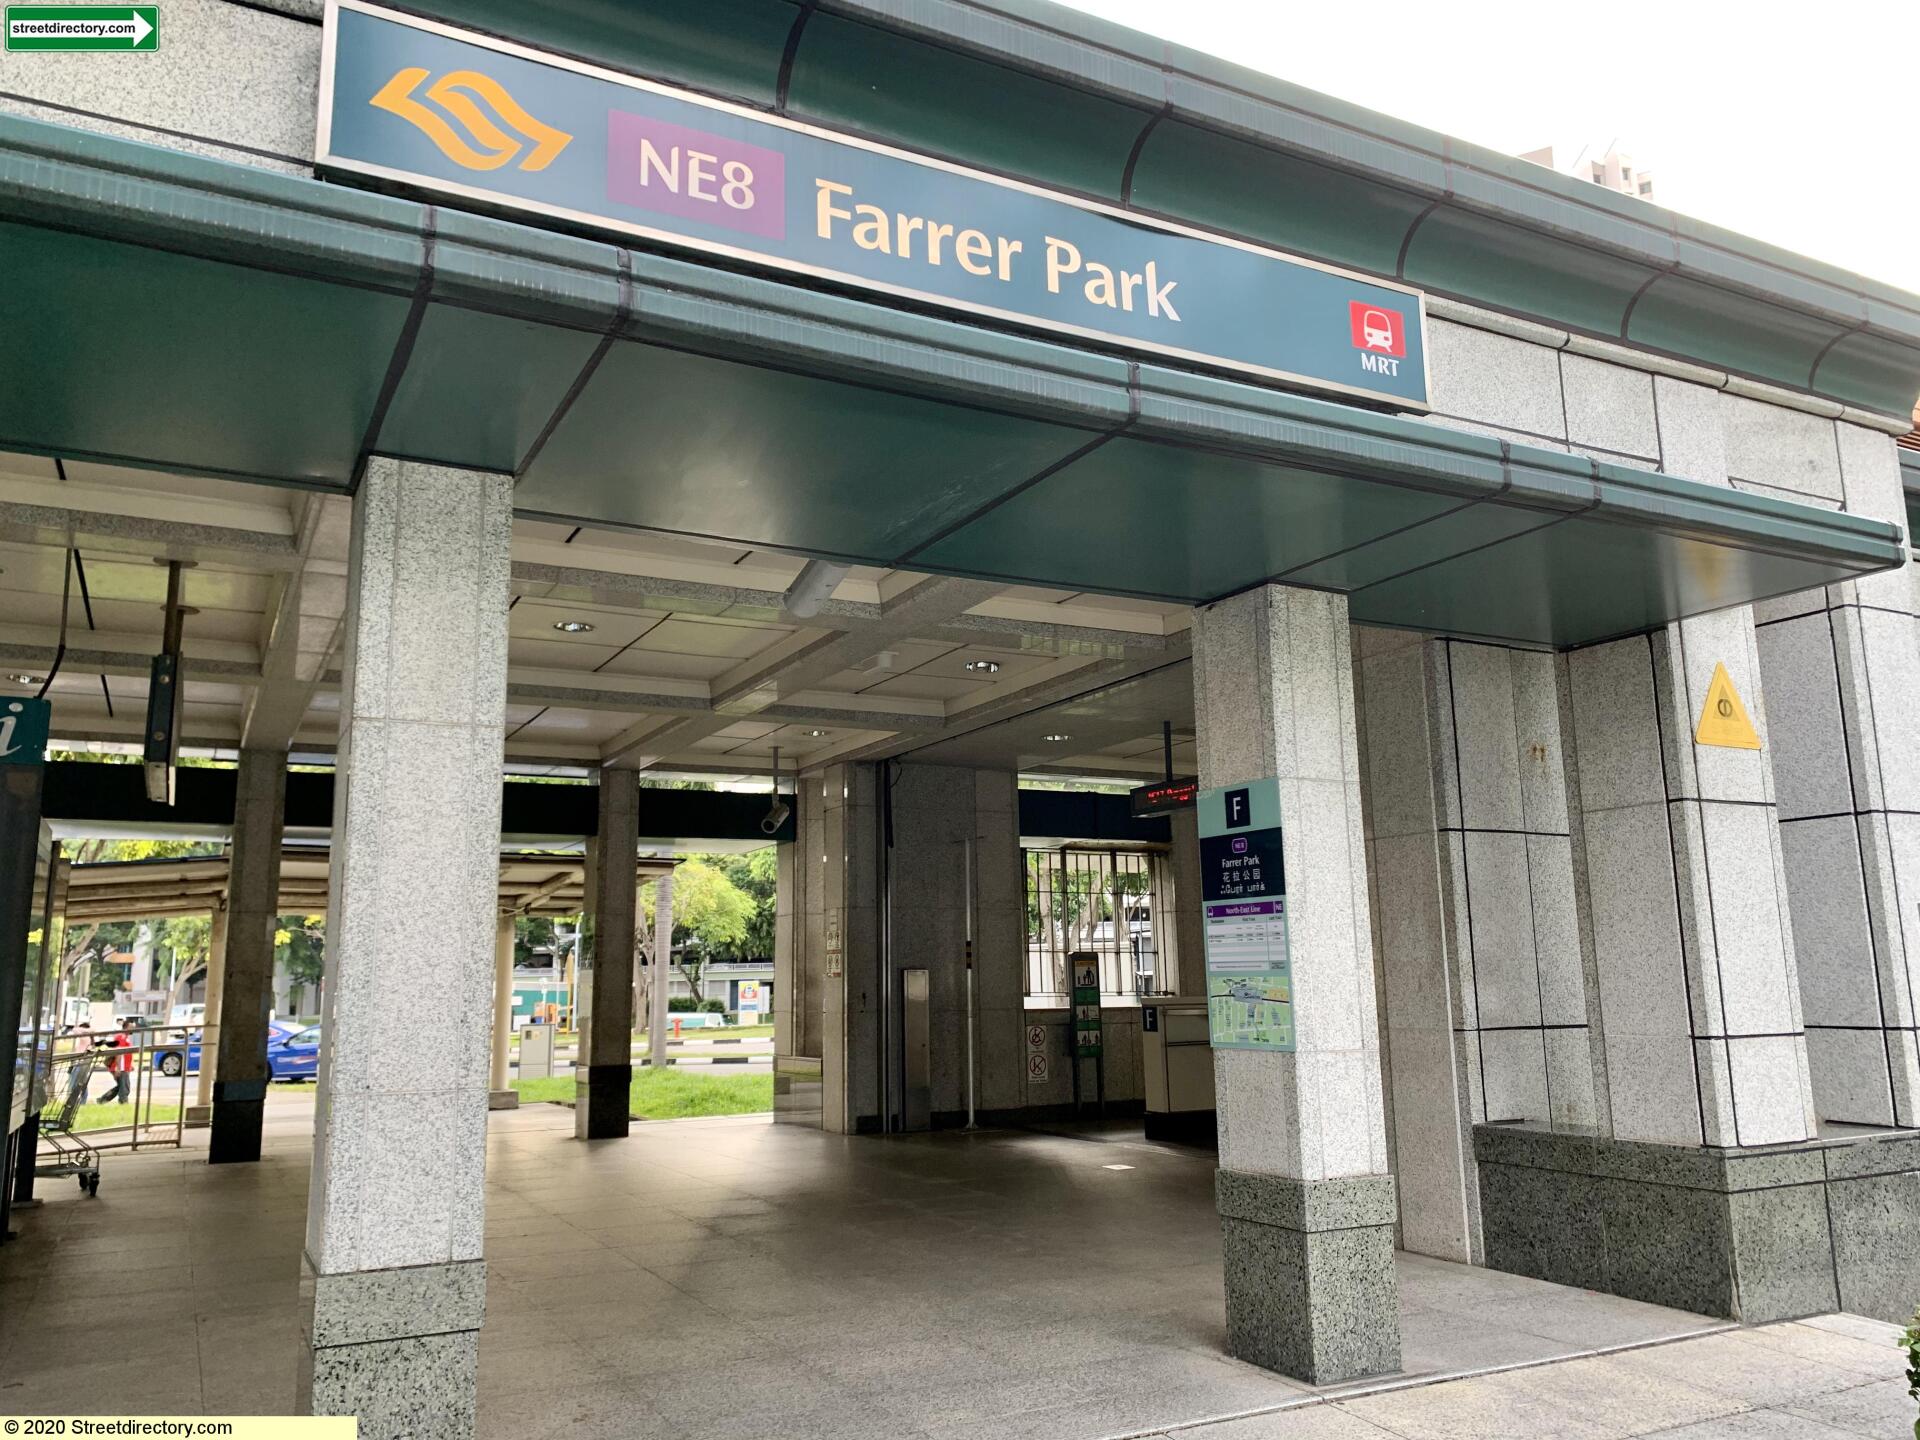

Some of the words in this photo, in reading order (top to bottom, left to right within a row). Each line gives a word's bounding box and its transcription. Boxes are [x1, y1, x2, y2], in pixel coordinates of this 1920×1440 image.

[639, 138, 756, 210] NE8
[815, 178, 1022, 282] Farrer
[1044, 235, 1182, 323] Park
[1361, 352, 1400, 377] MRT
[1232, 796, 1242, 821] F
[1221, 858, 1242, 868] Farrer
[1243, 855, 1260, 866] Park
[1222, 869, 1261, 883] 花拉公园
[1145, 1009, 1153, 1030] F
